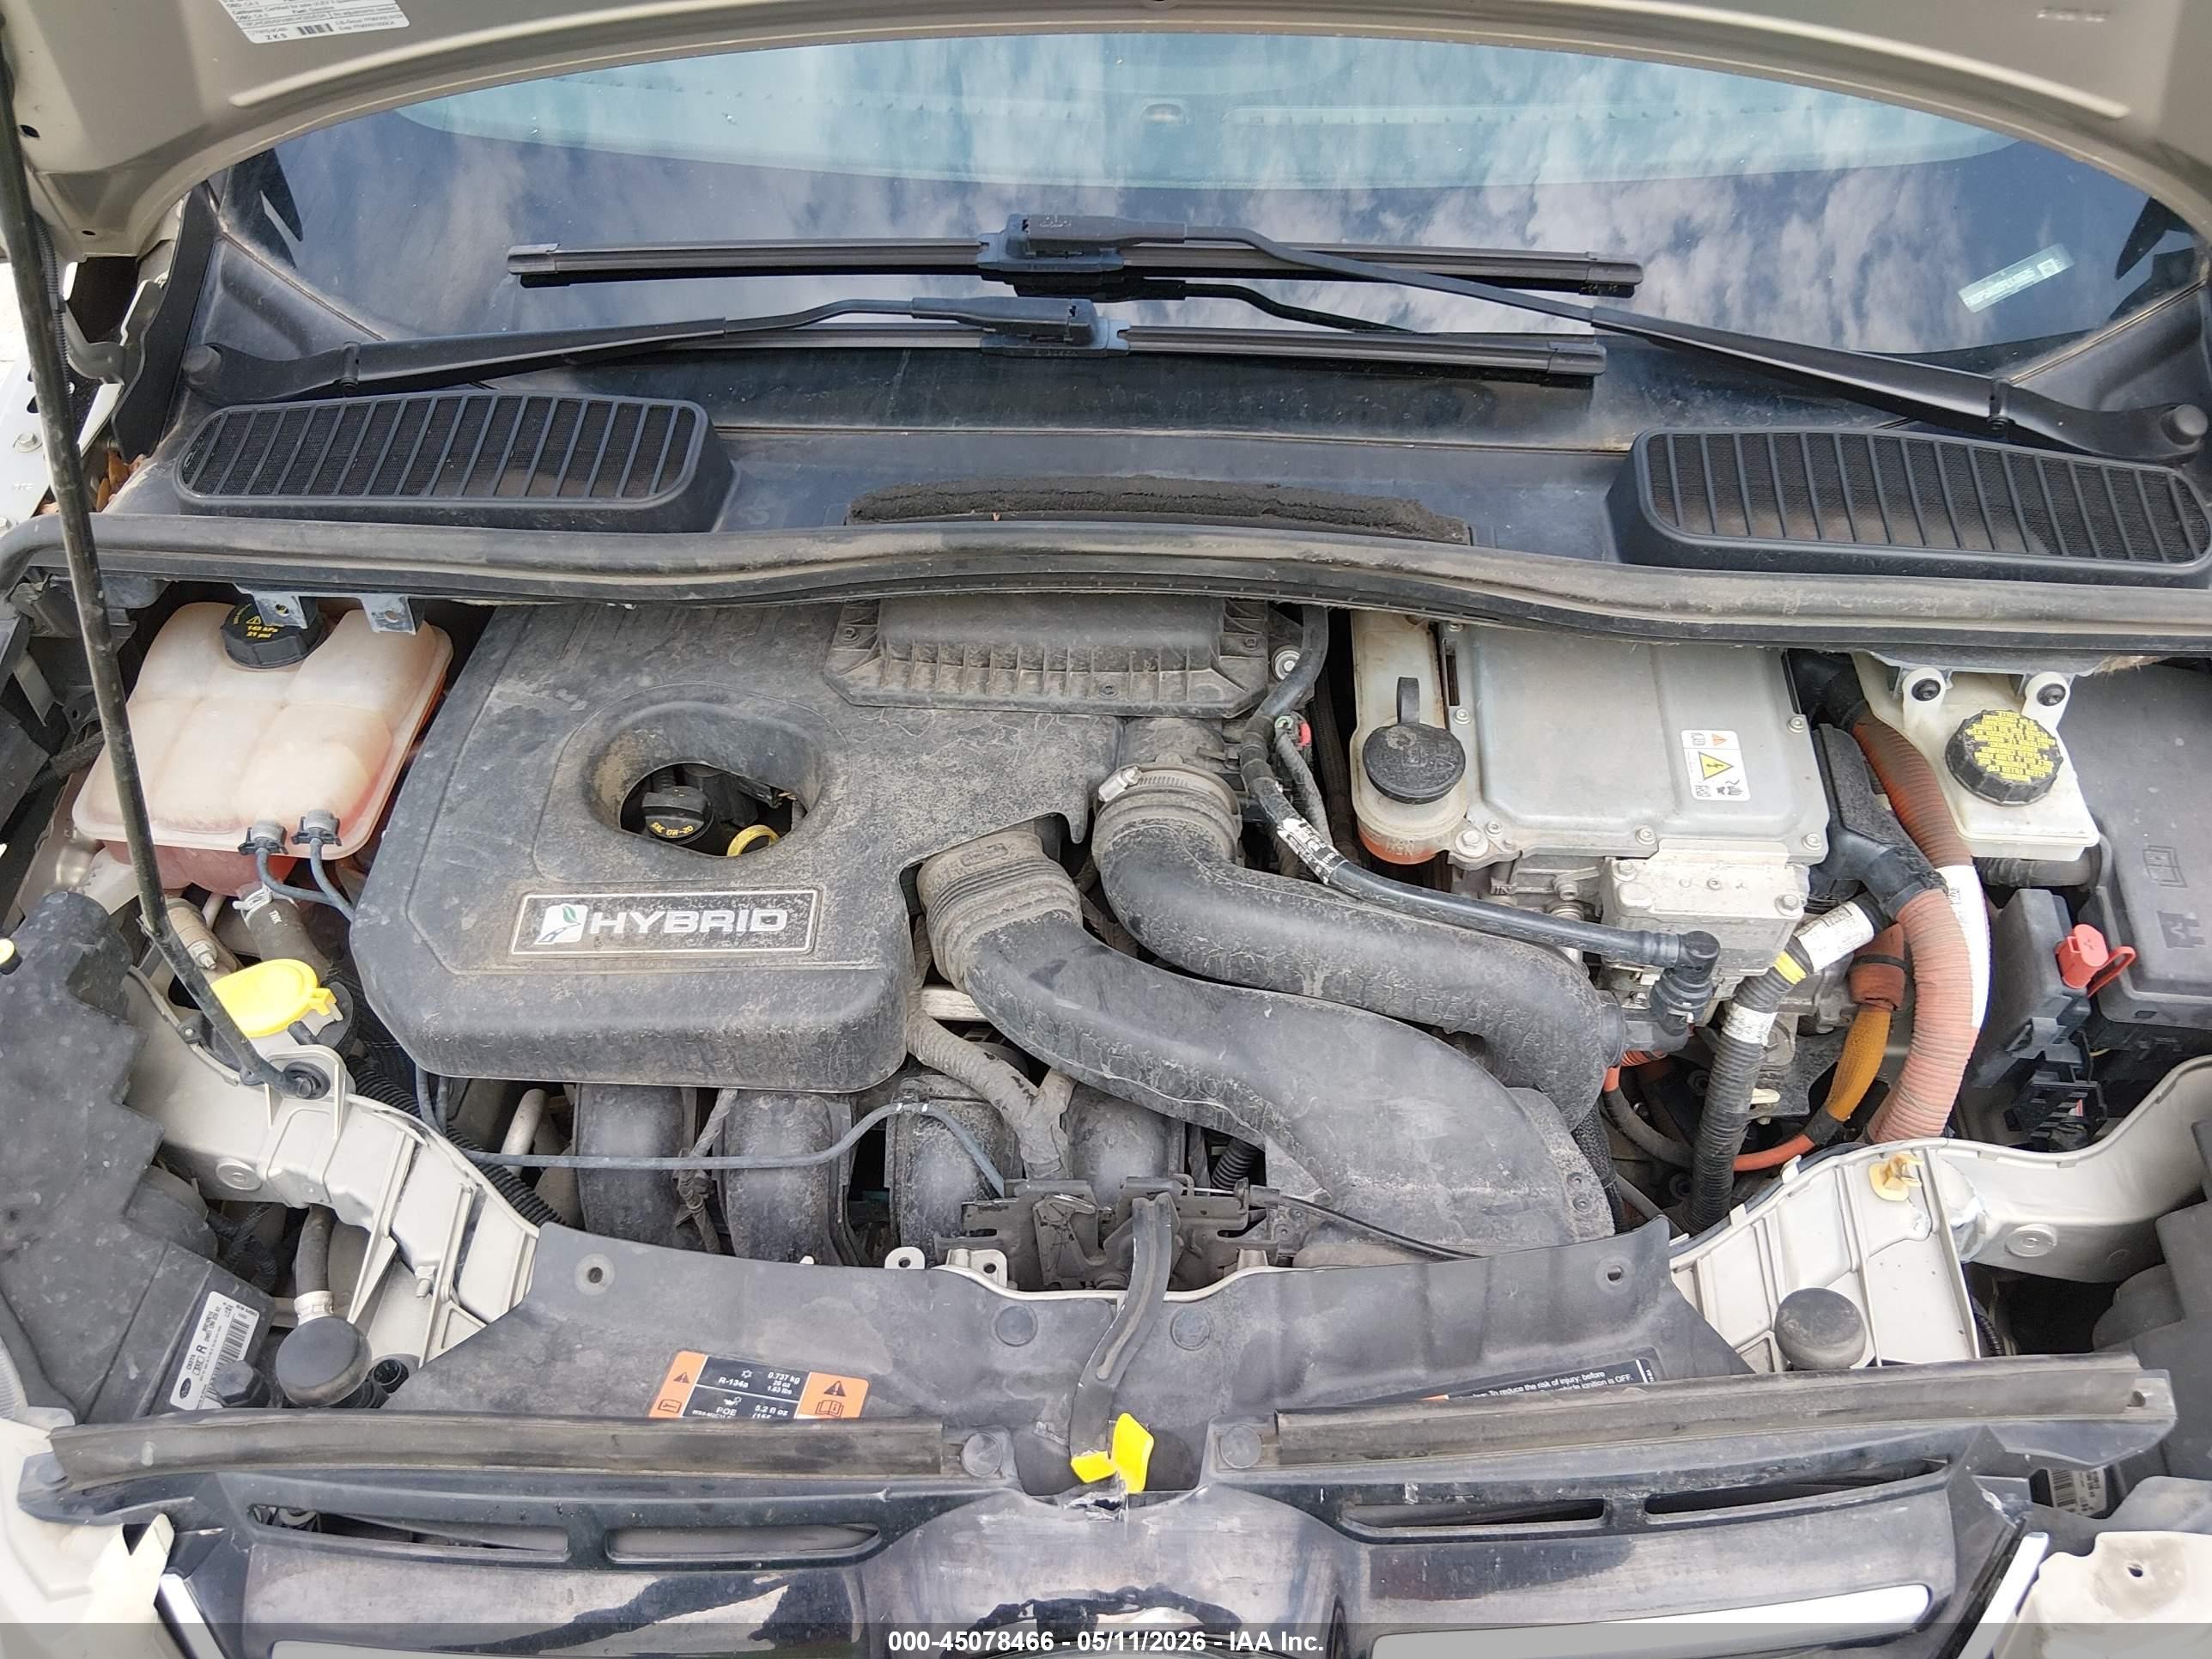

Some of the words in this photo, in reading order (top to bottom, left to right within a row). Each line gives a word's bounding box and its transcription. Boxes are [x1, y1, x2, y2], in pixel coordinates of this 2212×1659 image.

[590, 908, 788, 934] HYBRID
[718, 1377, 749, 1389] R-134a
[767, 1371, 790, 1382] 0.737
[790, 1375, 800, 1384] kg
[1498, 1385, 1524, 1396] reduce
[1523, 1382, 1537, 1391] the
[1537, 1379, 1551, 1389] risk
[1551, 1378, 1559, 1387] of
[1582, 1370, 1605, 1380] before
[1607, 1376, 1614, 1384] is
[1615, 1372, 1633, 1382] OFF.
